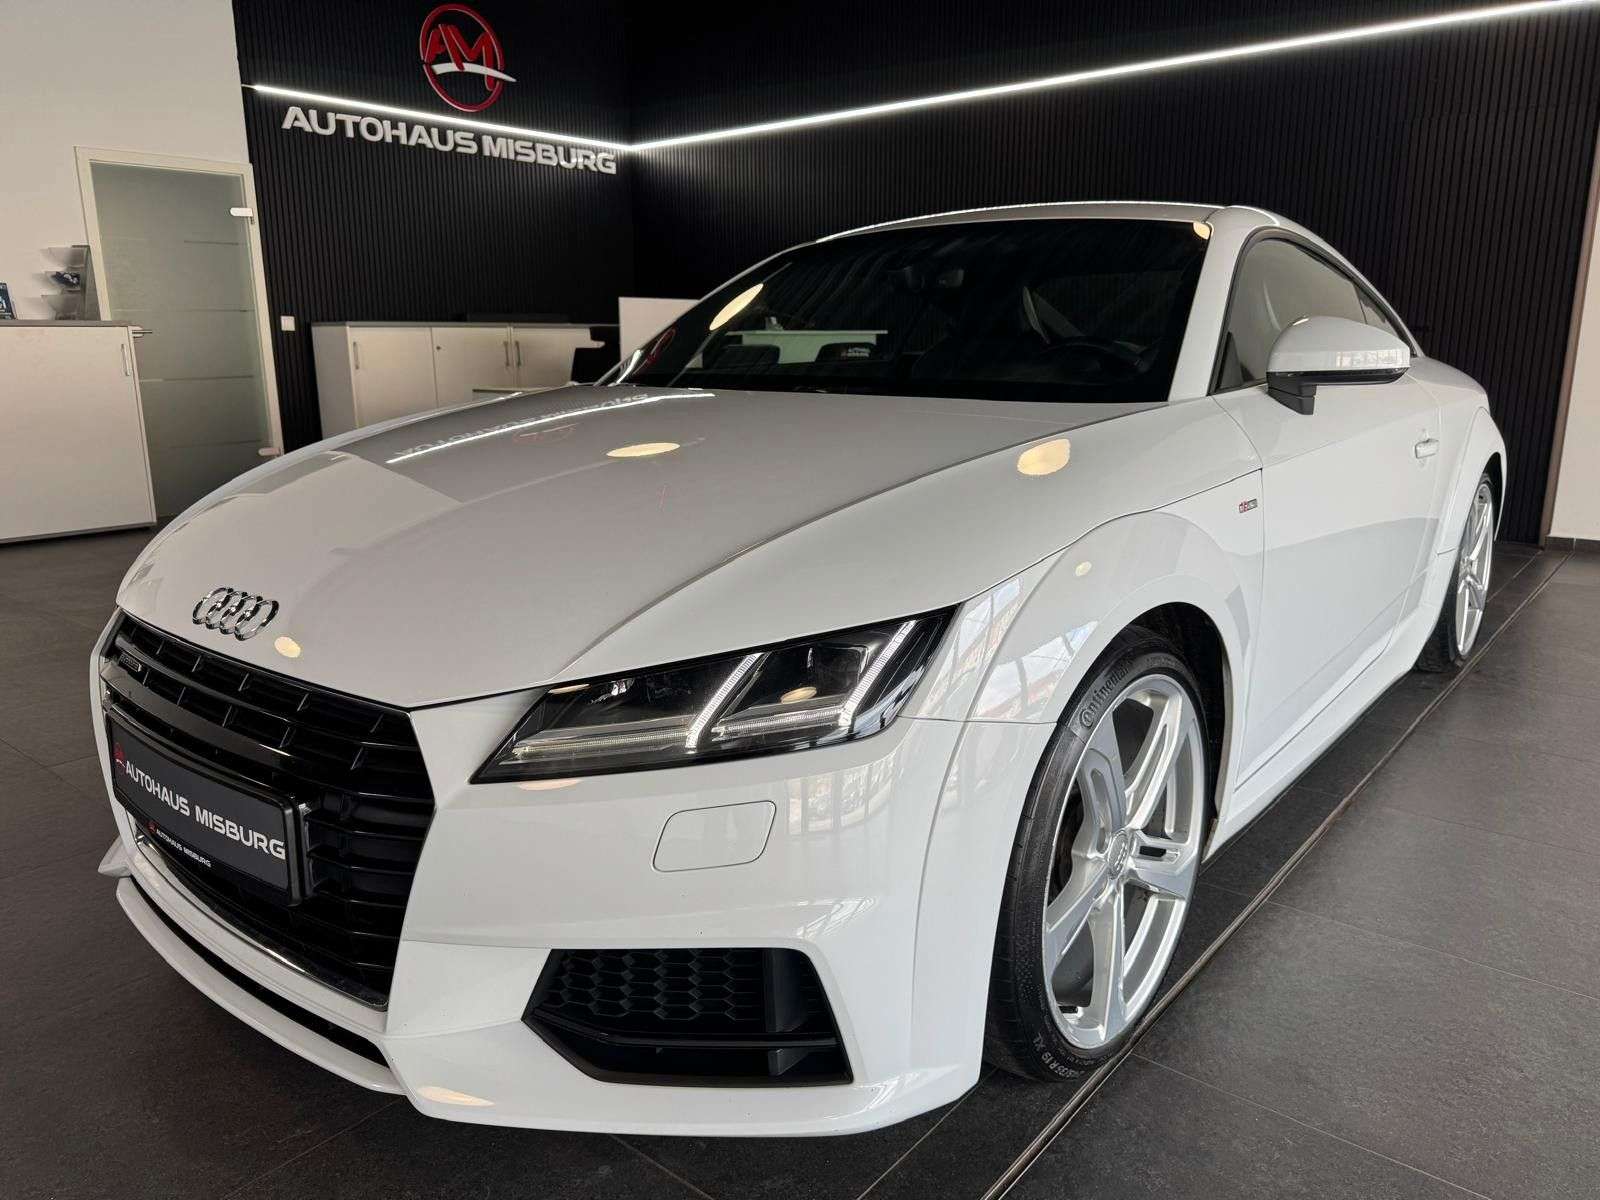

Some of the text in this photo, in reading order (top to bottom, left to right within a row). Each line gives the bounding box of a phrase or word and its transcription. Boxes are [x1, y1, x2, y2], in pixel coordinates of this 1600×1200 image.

[281, 106, 617, 174] AUTOHAUS MISBURG
[125, 760, 286, 860] AUTOHAUS MISBURG
